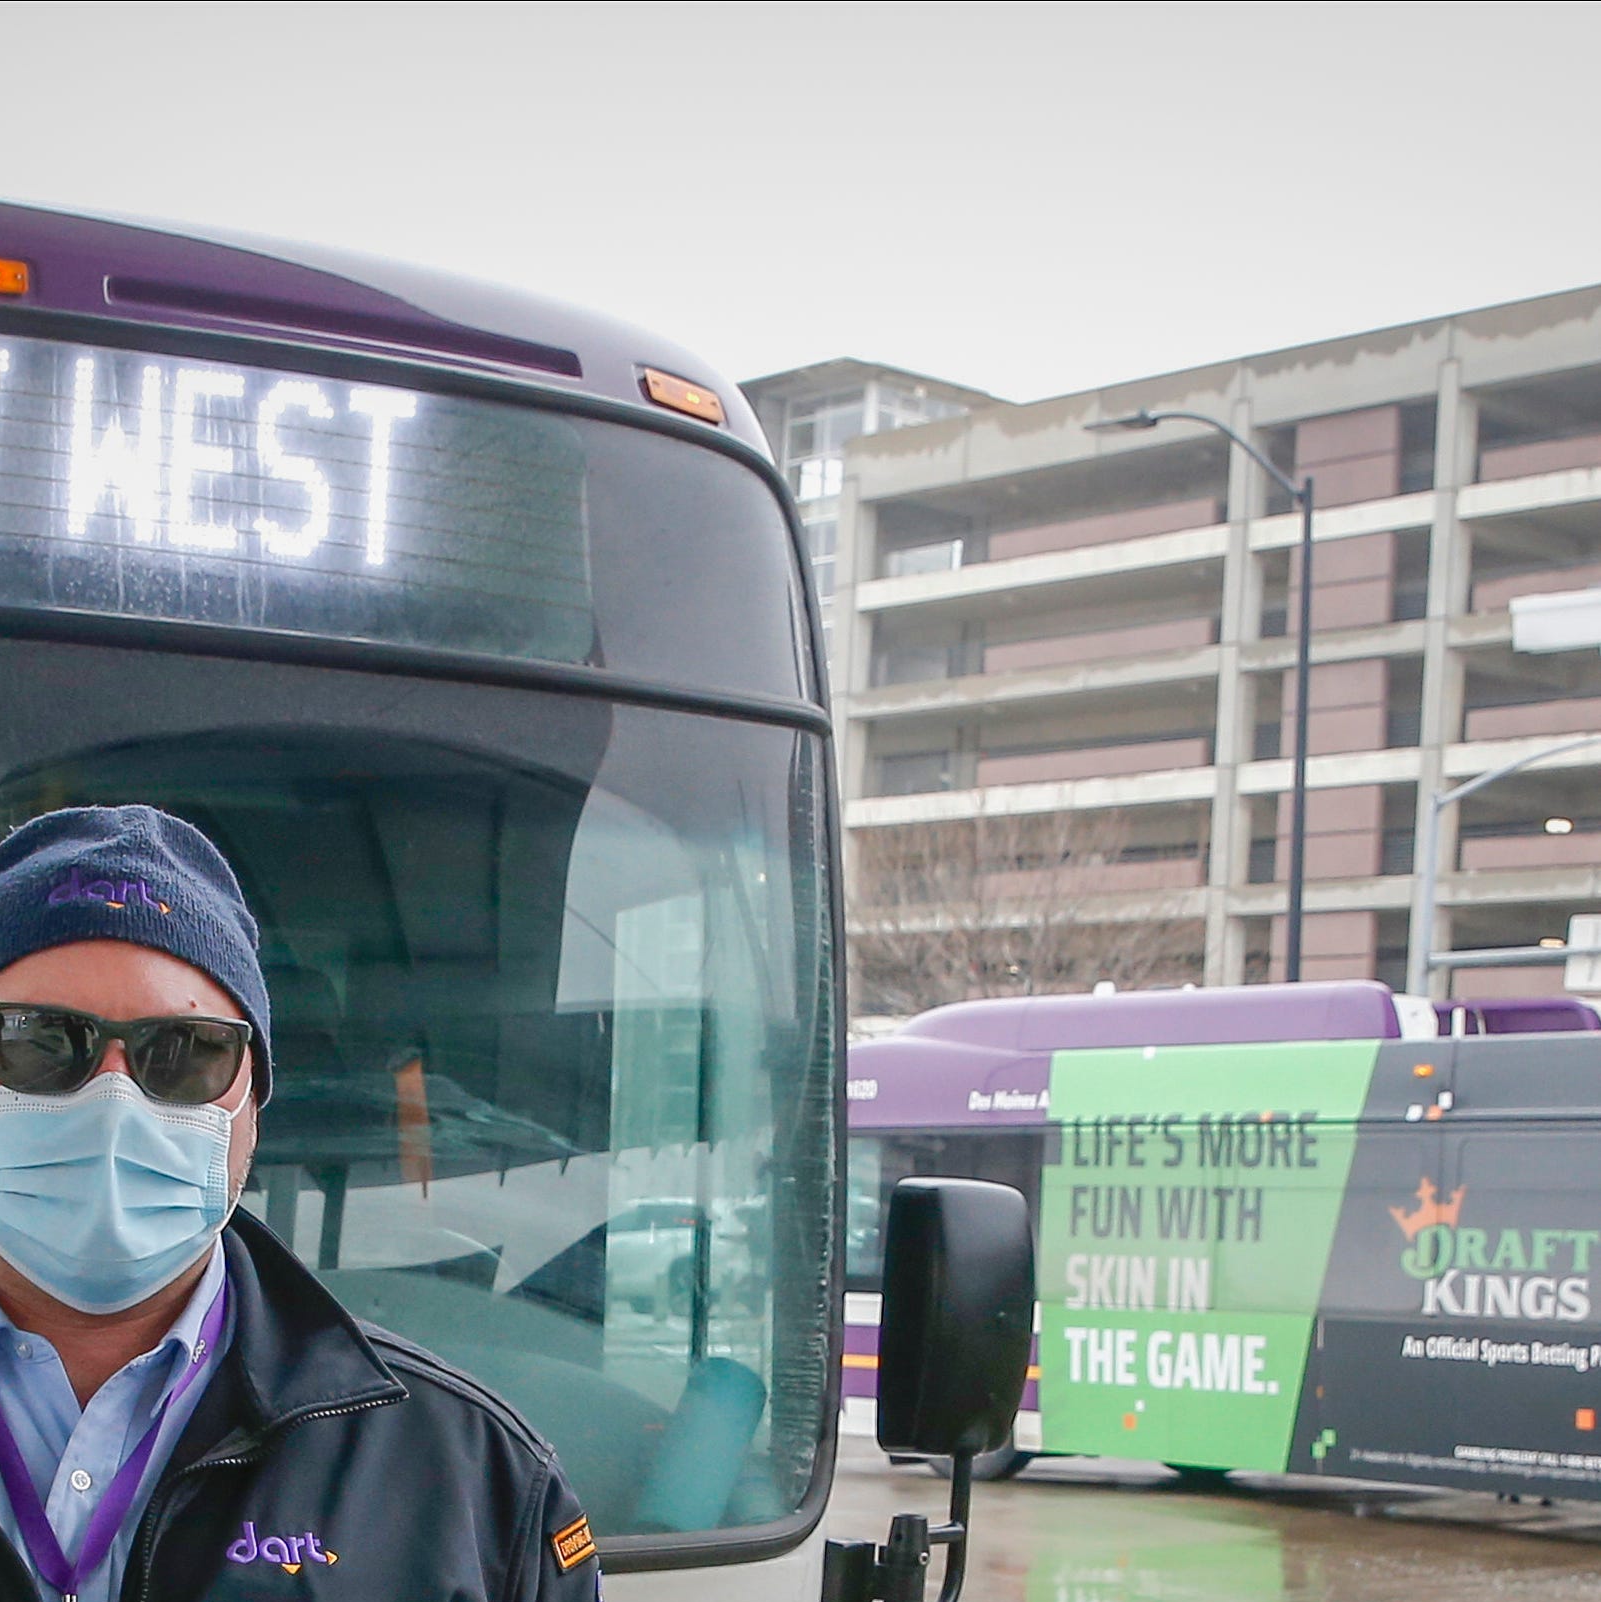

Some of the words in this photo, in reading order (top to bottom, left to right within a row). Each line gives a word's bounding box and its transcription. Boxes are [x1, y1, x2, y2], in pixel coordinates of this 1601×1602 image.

[67, 357, 417, 566] WEST
[1072, 1112, 1184, 1168] LIFE'S
[1200, 1110, 1319, 1168] MORE
[1069, 1185, 1142, 1239] FUN
[1156, 1185, 1263, 1242] WITH
[1401, 1223, 1601, 1280] DRAFT
[1064, 1253, 1157, 1312] SKIN
[1167, 1256, 1211, 1313] IN
[1421, 1269, 1591, 1322] KINGS
[1064, 1326, 1138, 1386] THE
[1146, 1330, 1280, 1395] GAME.
[226, 1520, 334, 1567] dart
